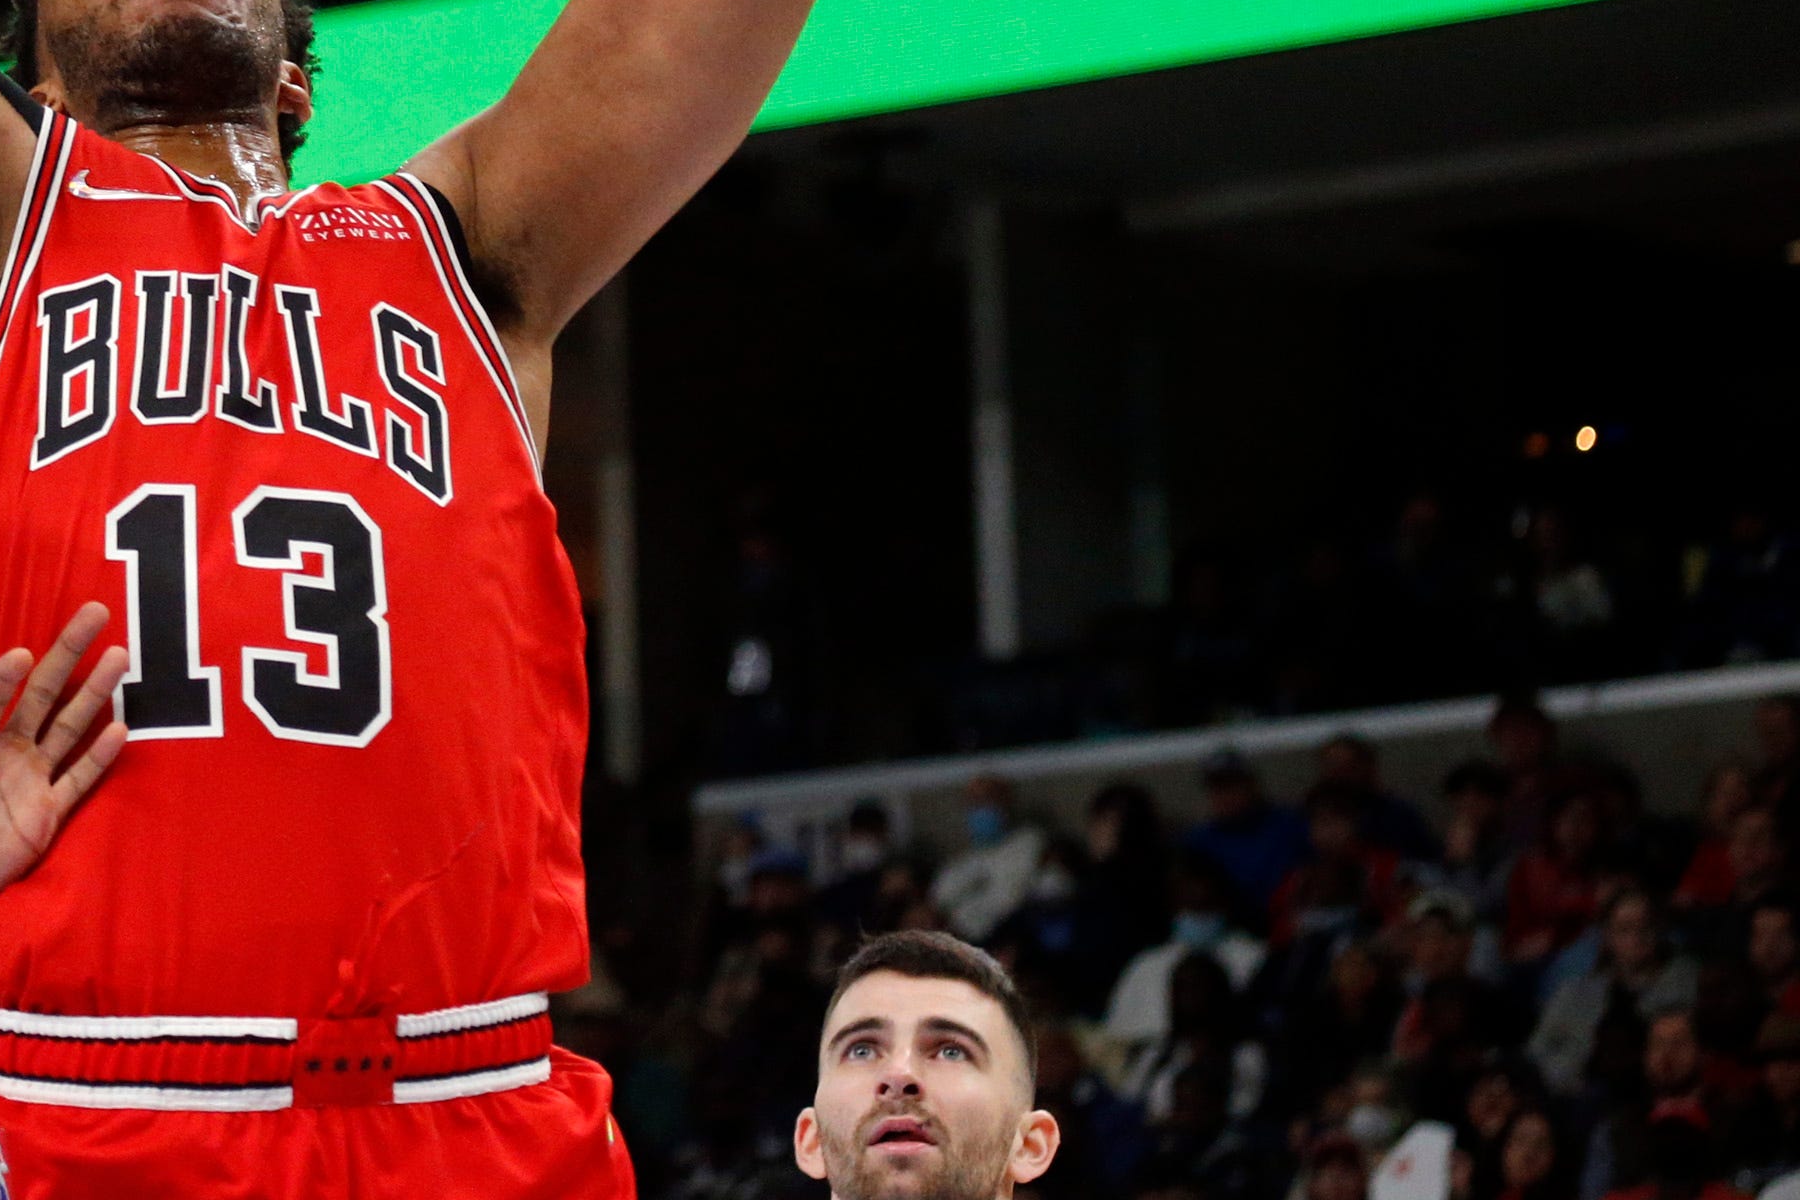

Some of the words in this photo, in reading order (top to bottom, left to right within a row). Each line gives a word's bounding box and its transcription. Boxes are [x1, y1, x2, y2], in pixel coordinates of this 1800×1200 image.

[302, 227, 412, 242] EYEWEAR
[29, 262, 454, 507] BULLS
[105, 482, 393, 749] 13
